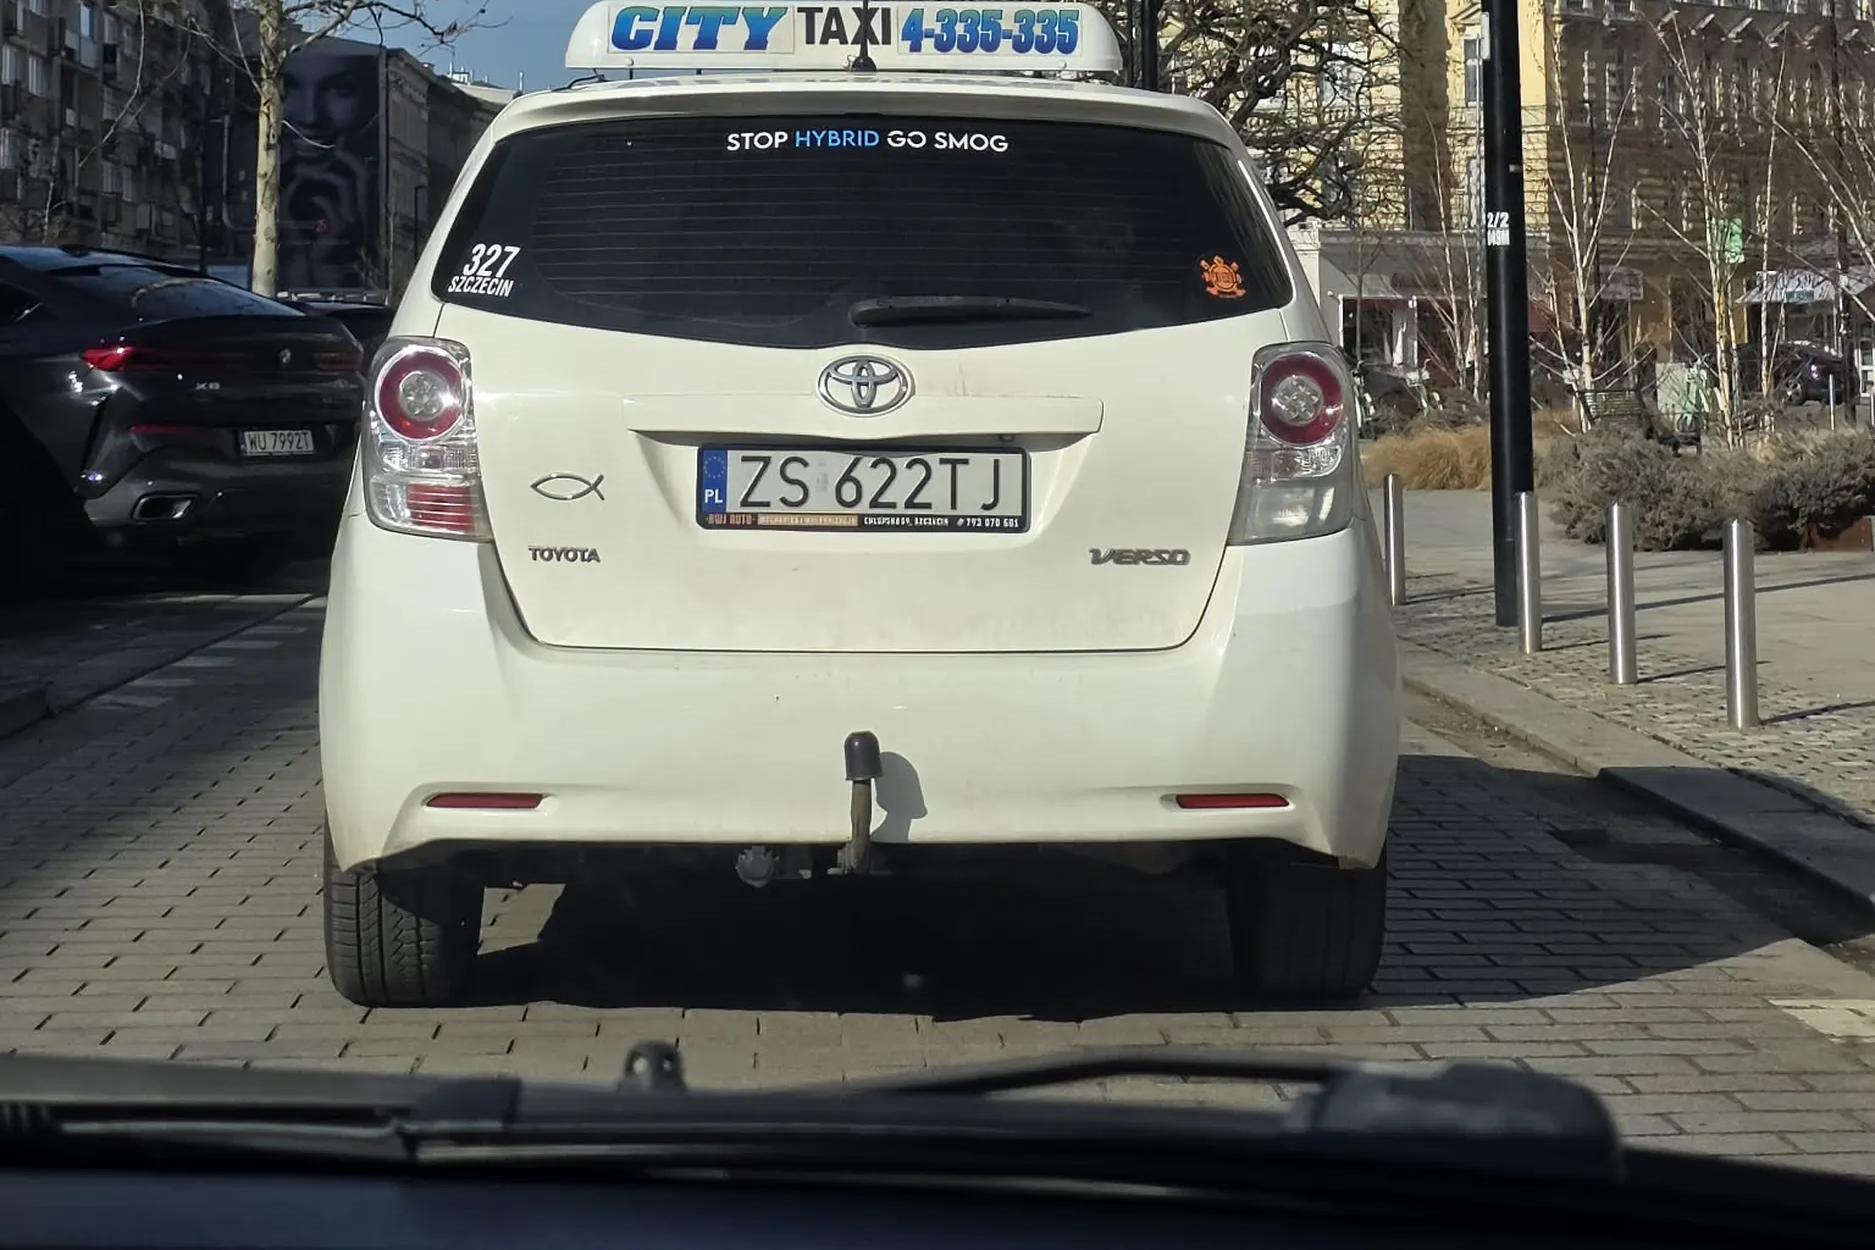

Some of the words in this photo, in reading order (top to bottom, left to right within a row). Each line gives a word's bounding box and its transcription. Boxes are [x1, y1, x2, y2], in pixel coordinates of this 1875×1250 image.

[610, 6, 787, 50] CITY
[797, 6, 892, 46] TAXI
[901, 8, 1080, 55] 4-335-335
[727, 131, 788, 151] STOP
[795, 130, 879, 147] HYBRID
[887, 130, 927, 148] GO
[934, 131, 1009, 152] SMOG
[1487, 211, 1509, 228] 2/2
[463, 243, 521, 278] 327
[447, 275, 515, 297] SZCZECIN
[248, 432, 267, 451] WU
[740, 455, 809, 508] ZS
[835, 456, 1000, 511] 622TJ
[704, 488, 723, 504] PL
[528, 545, 601, 563] TOYOTA
[1088, 548, 1191, 566] VERSO
